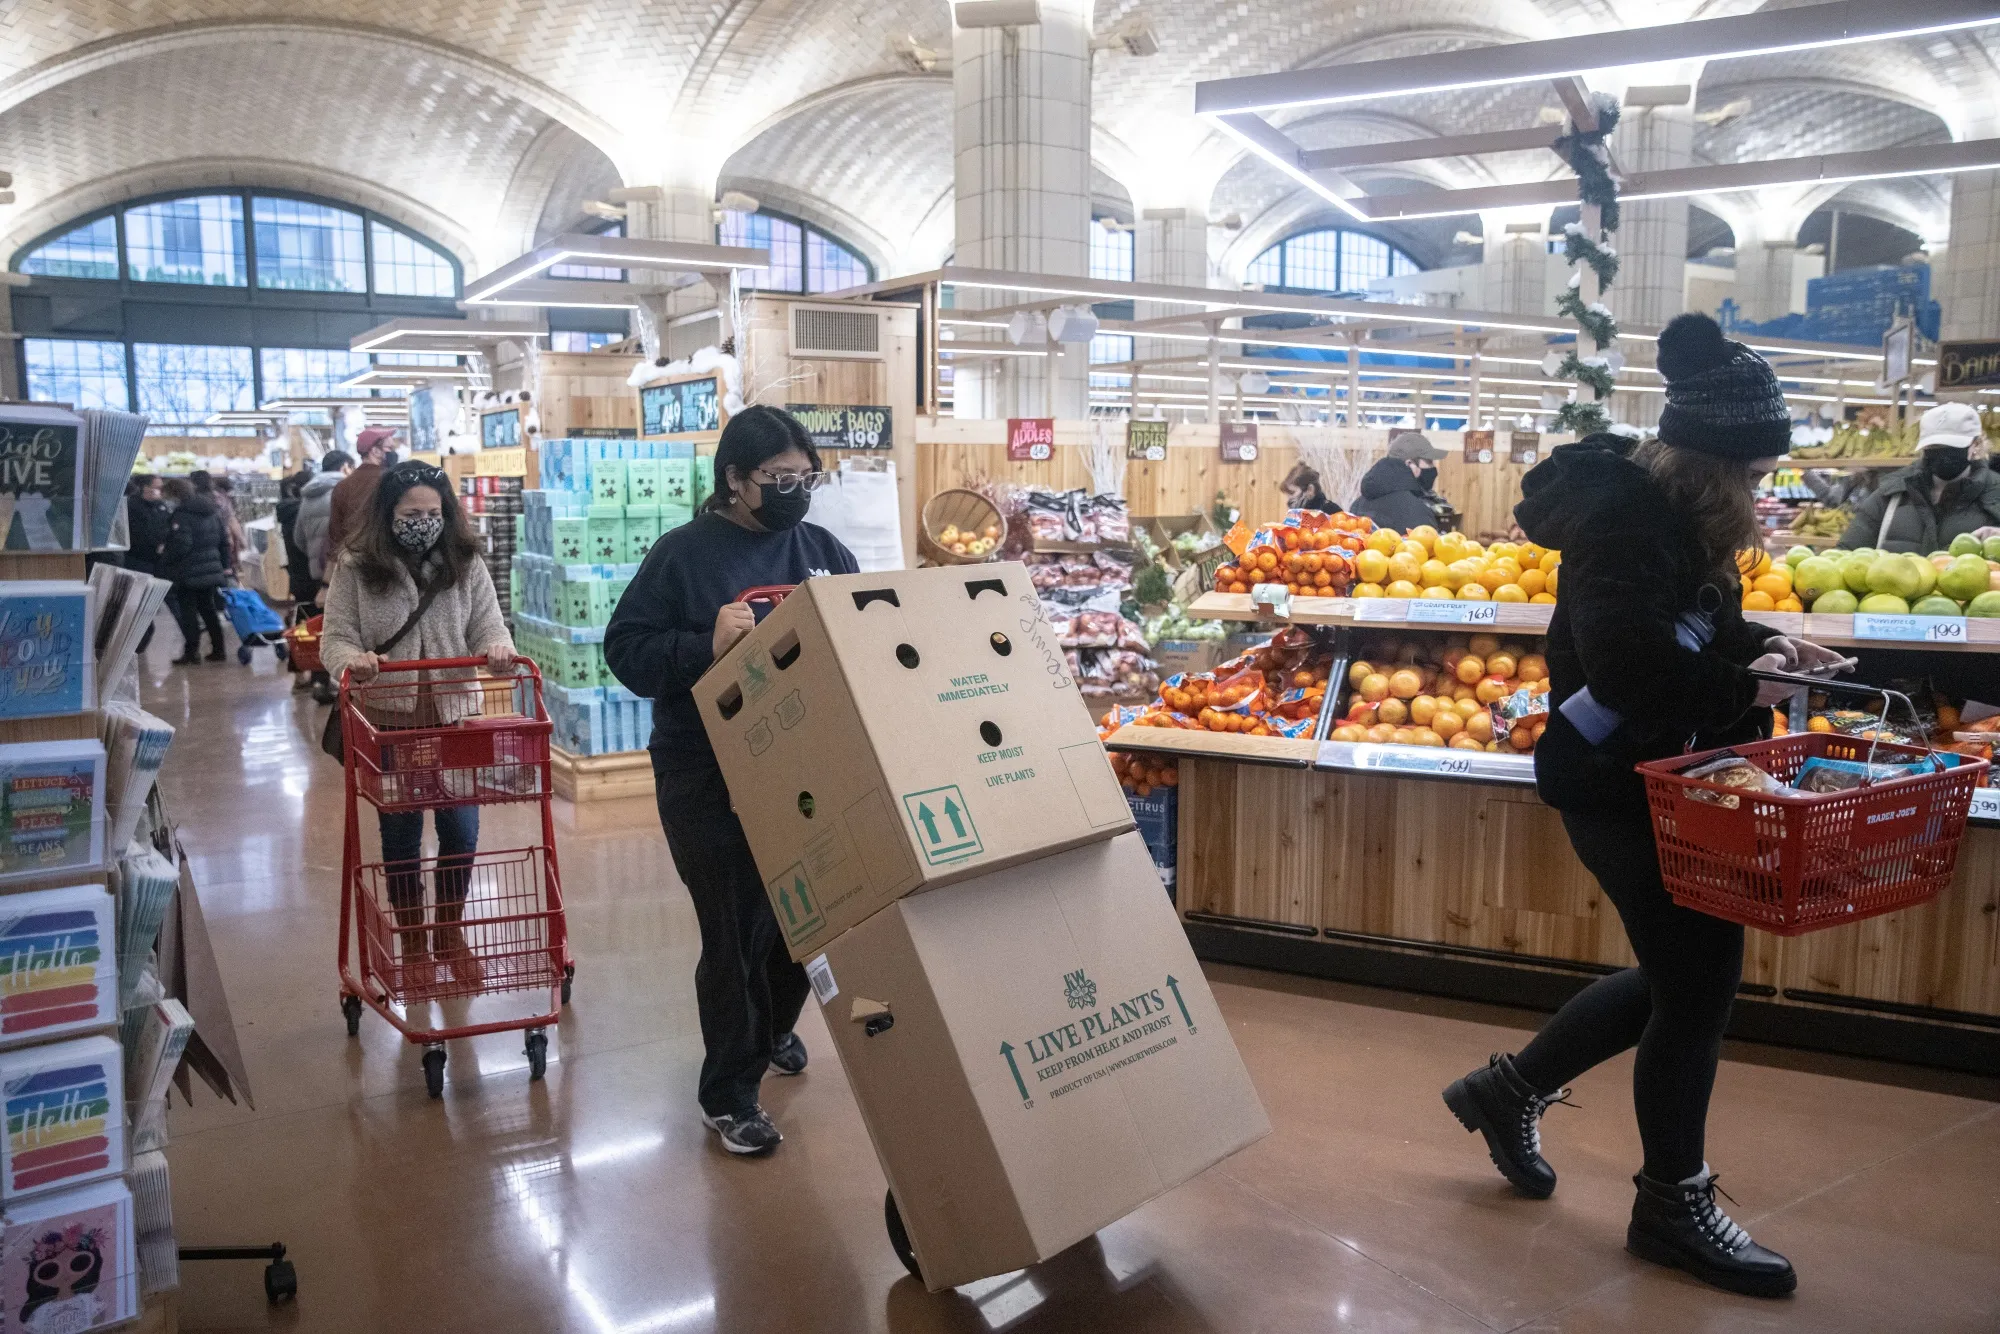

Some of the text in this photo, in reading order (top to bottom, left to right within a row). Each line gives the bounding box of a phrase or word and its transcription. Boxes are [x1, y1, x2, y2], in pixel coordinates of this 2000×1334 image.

[847, 411, 885, 433] BAGS
[0, 426, 62, 464] igh
[1012, 428, 1051, 451] APPLES
[1128, 431, 1166, 456] APPLES
[0, 459, 53, 485] IVE
[950, 674, 989, 687] WATER
[937, 683, 1010, 702] IMMEDIATELY
[977, 746, 1024, 764] KEEP MOIST
[15, 776, 66, 791] LETTUCE
[985, 768, 1036, 787] LIVE PLANTS
[1128, 802, 1165, 813] CITRUS
[1867, 806, 1918, 825] TRADER JOE'S
[20, 841, 60, 855] BEANS
[12, 936, 87, 990] Hello
[1024, 988, 1165, 1064] LIVE PLANTS
[1188, 1026, 1198, 1036] UP
[1036, 1014, 1173, 1082] KEEP FROM HEAT AND FROST
[1050, 1079, 1084, 1099] PRODUCT
[1083, 1074, 1094, 1085] OF
[1023, 1100, 1035, 1110] UP
[22, 1089, 97, 1145] Hello
